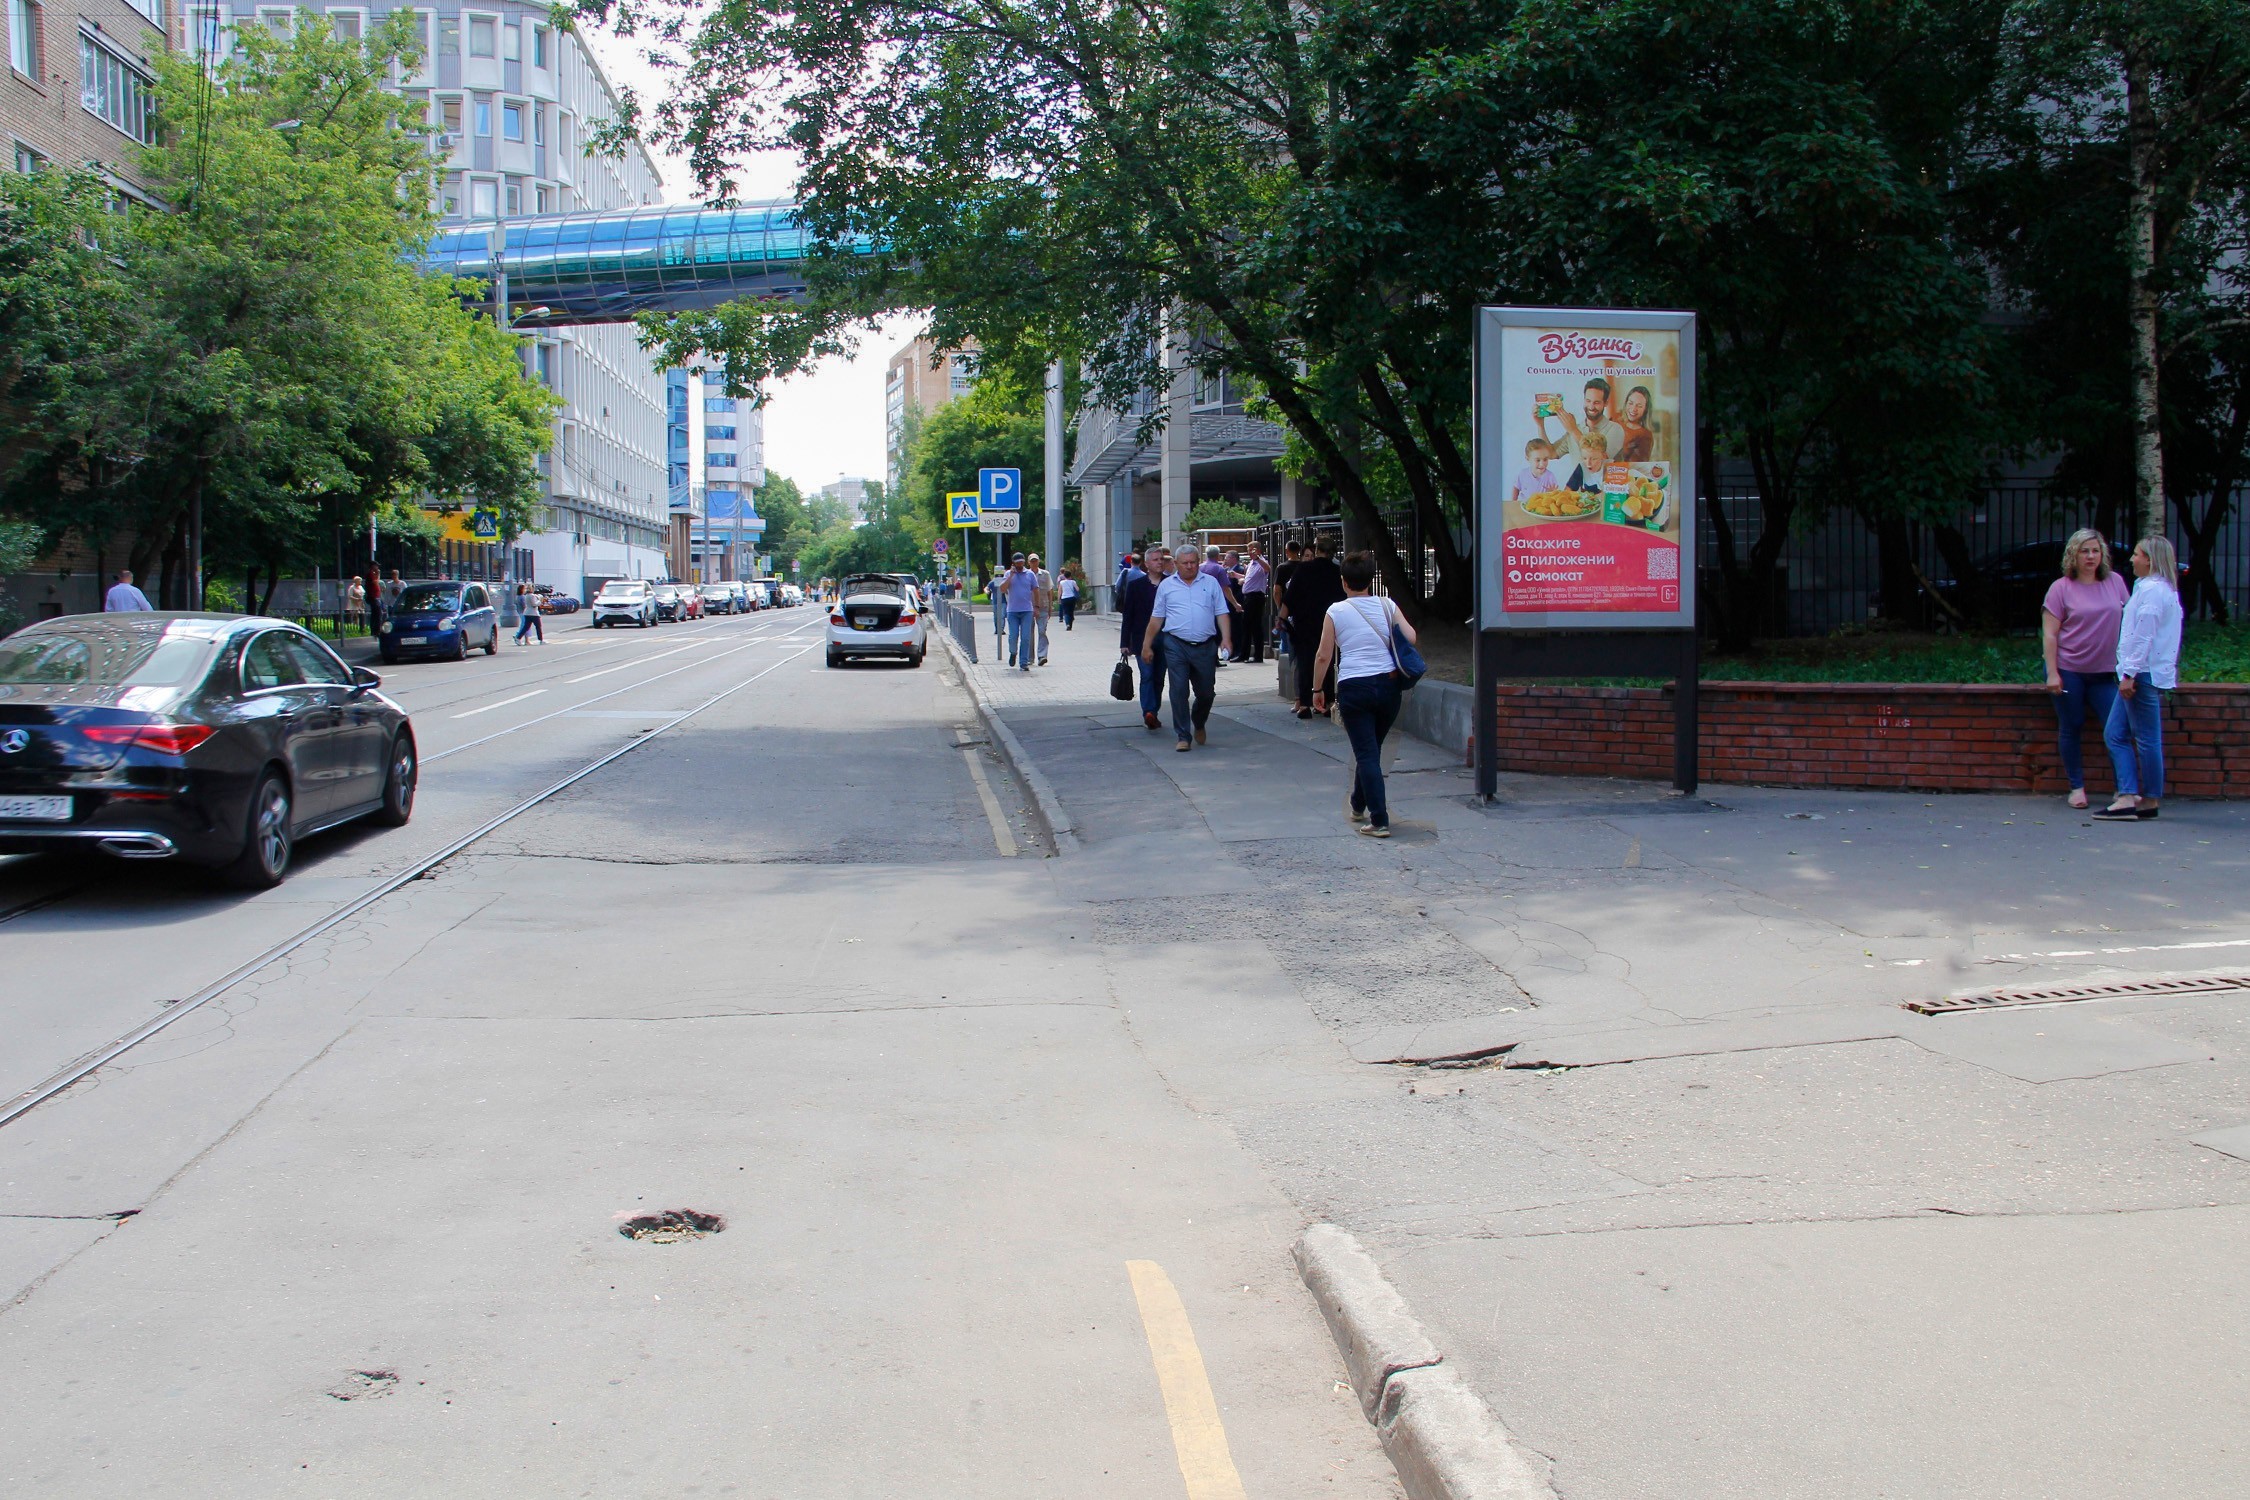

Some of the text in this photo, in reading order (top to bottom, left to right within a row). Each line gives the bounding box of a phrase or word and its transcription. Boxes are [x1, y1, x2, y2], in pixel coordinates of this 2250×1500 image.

[1537, 332, 1641, 364] Вязанка
[1527, 366, 1656, 377] Сочность, хруст и улыбки!
[991, 473, 1012, 504] P
[993, 519, 1000, 527] 15
[1003, 519, 1014, 527] 20
[1507, 536, 1580, 549] Закажите
[1507, 555, 1615, 568] в приложении
[1524, 571, 1584, 581] самокат
[1665, 588, 1675, 600] 6+
